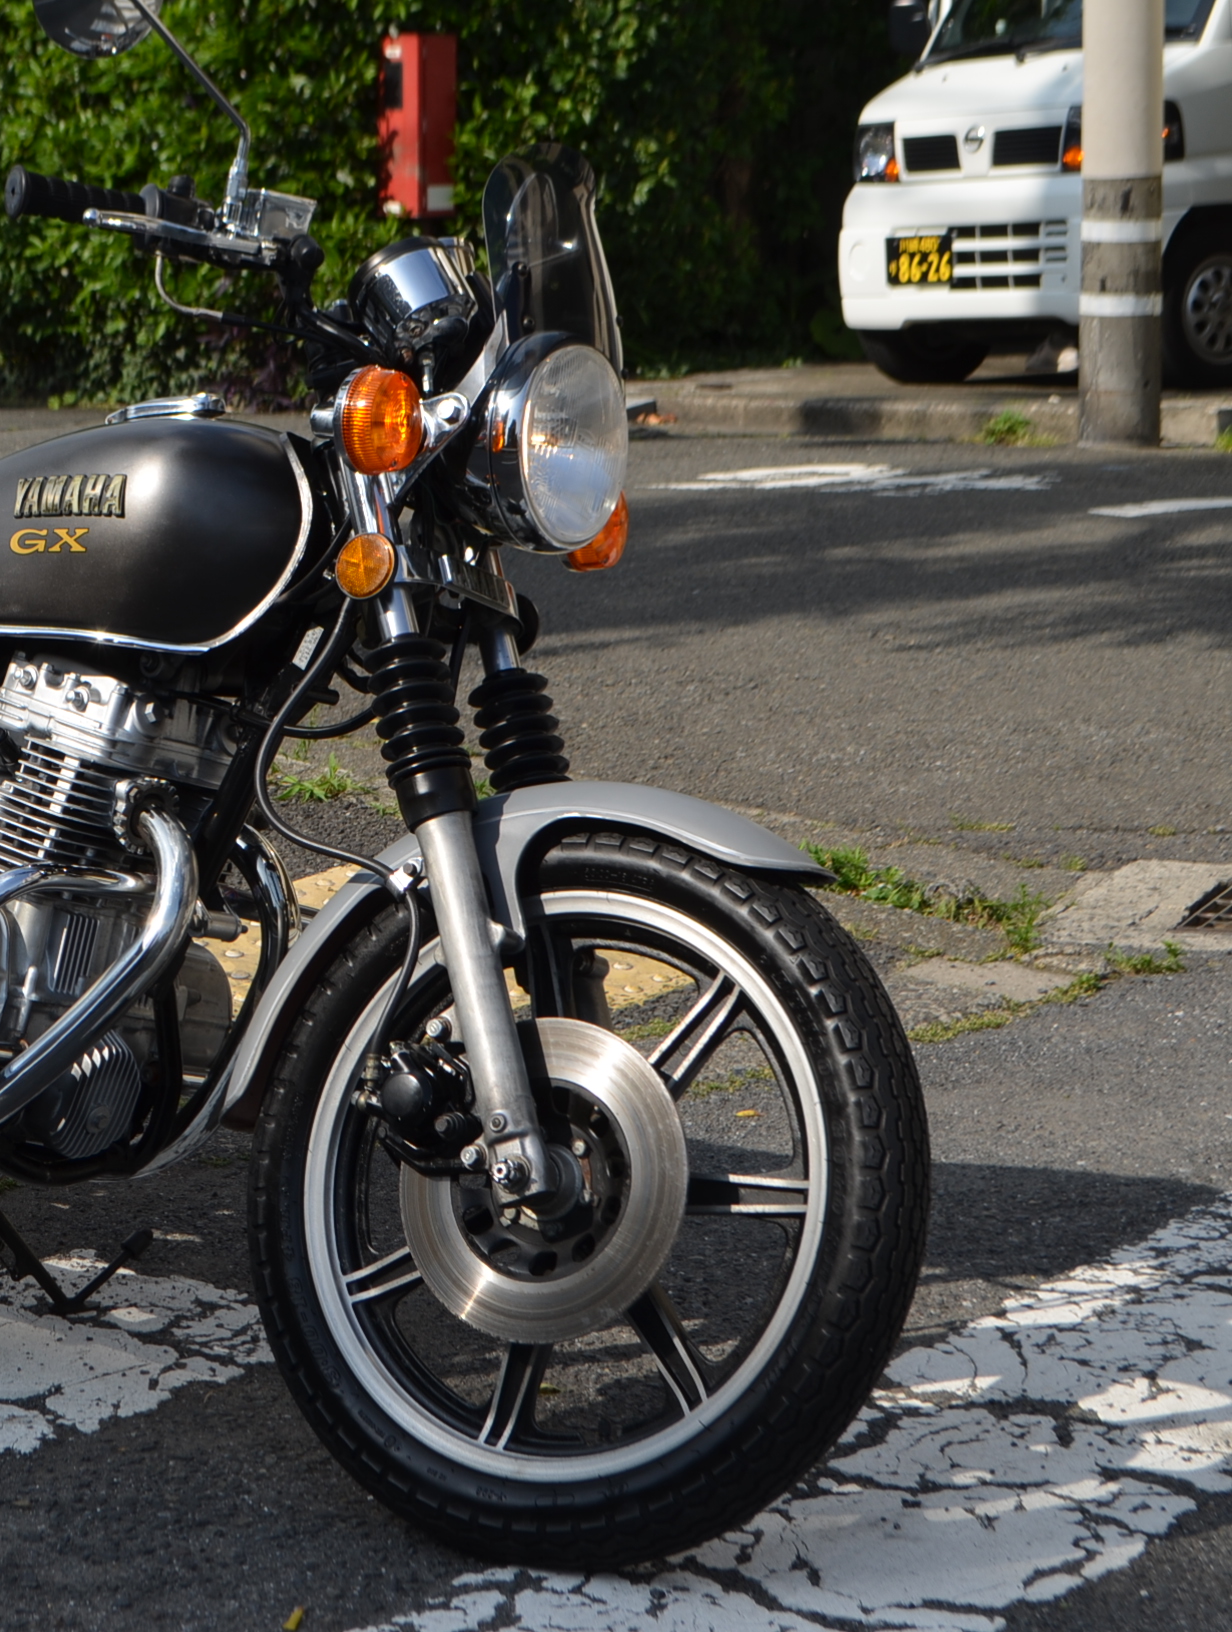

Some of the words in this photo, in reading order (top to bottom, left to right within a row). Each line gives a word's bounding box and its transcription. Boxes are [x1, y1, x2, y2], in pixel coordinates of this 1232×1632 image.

[899, 250, 951, 283] 86-26
[14, 474, 126, 519] YAMAHA
[9, 528, 89, 555] GX
